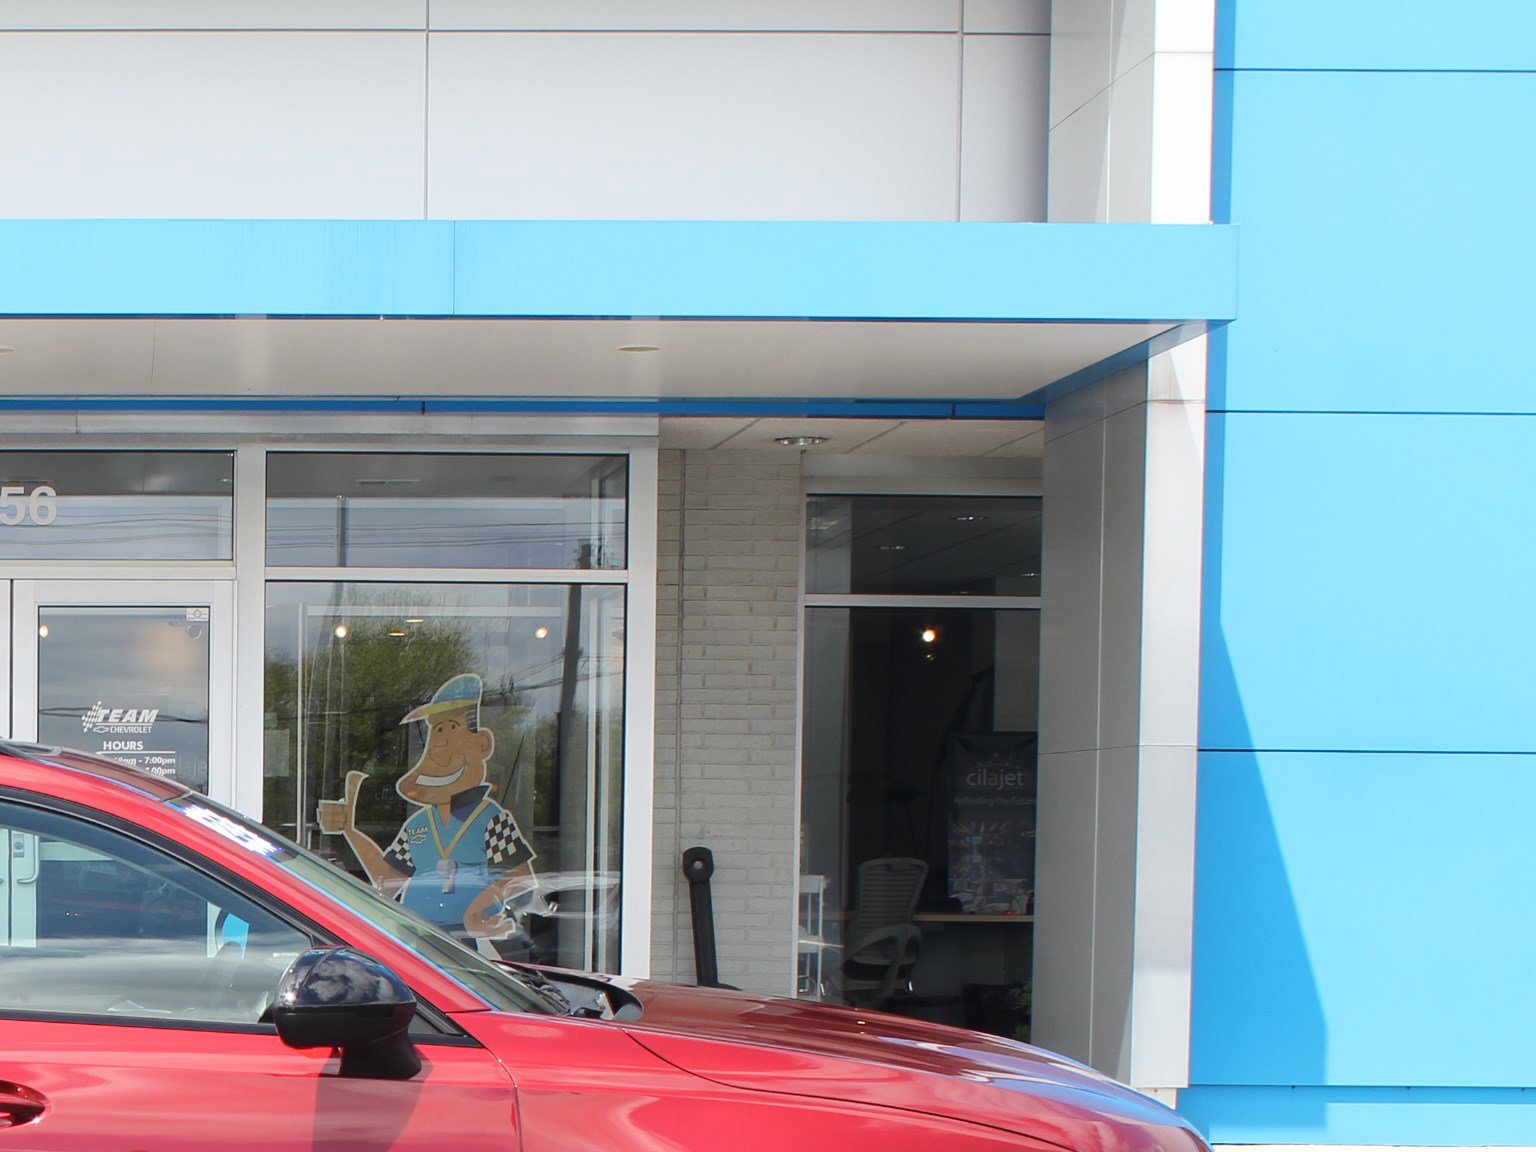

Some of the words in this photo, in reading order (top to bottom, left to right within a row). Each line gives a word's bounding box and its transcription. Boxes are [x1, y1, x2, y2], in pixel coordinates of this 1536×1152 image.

[96, 708, 159, 723] TEAM
[109, 725, 152, 734] CHEVROLET
[103, 740, 144, 751] HOURS
[144, 756, 176, 766] 7:00pm
[966, 768, 1024, 791] cilajet
[407, 826, 429, 836] TEAM
